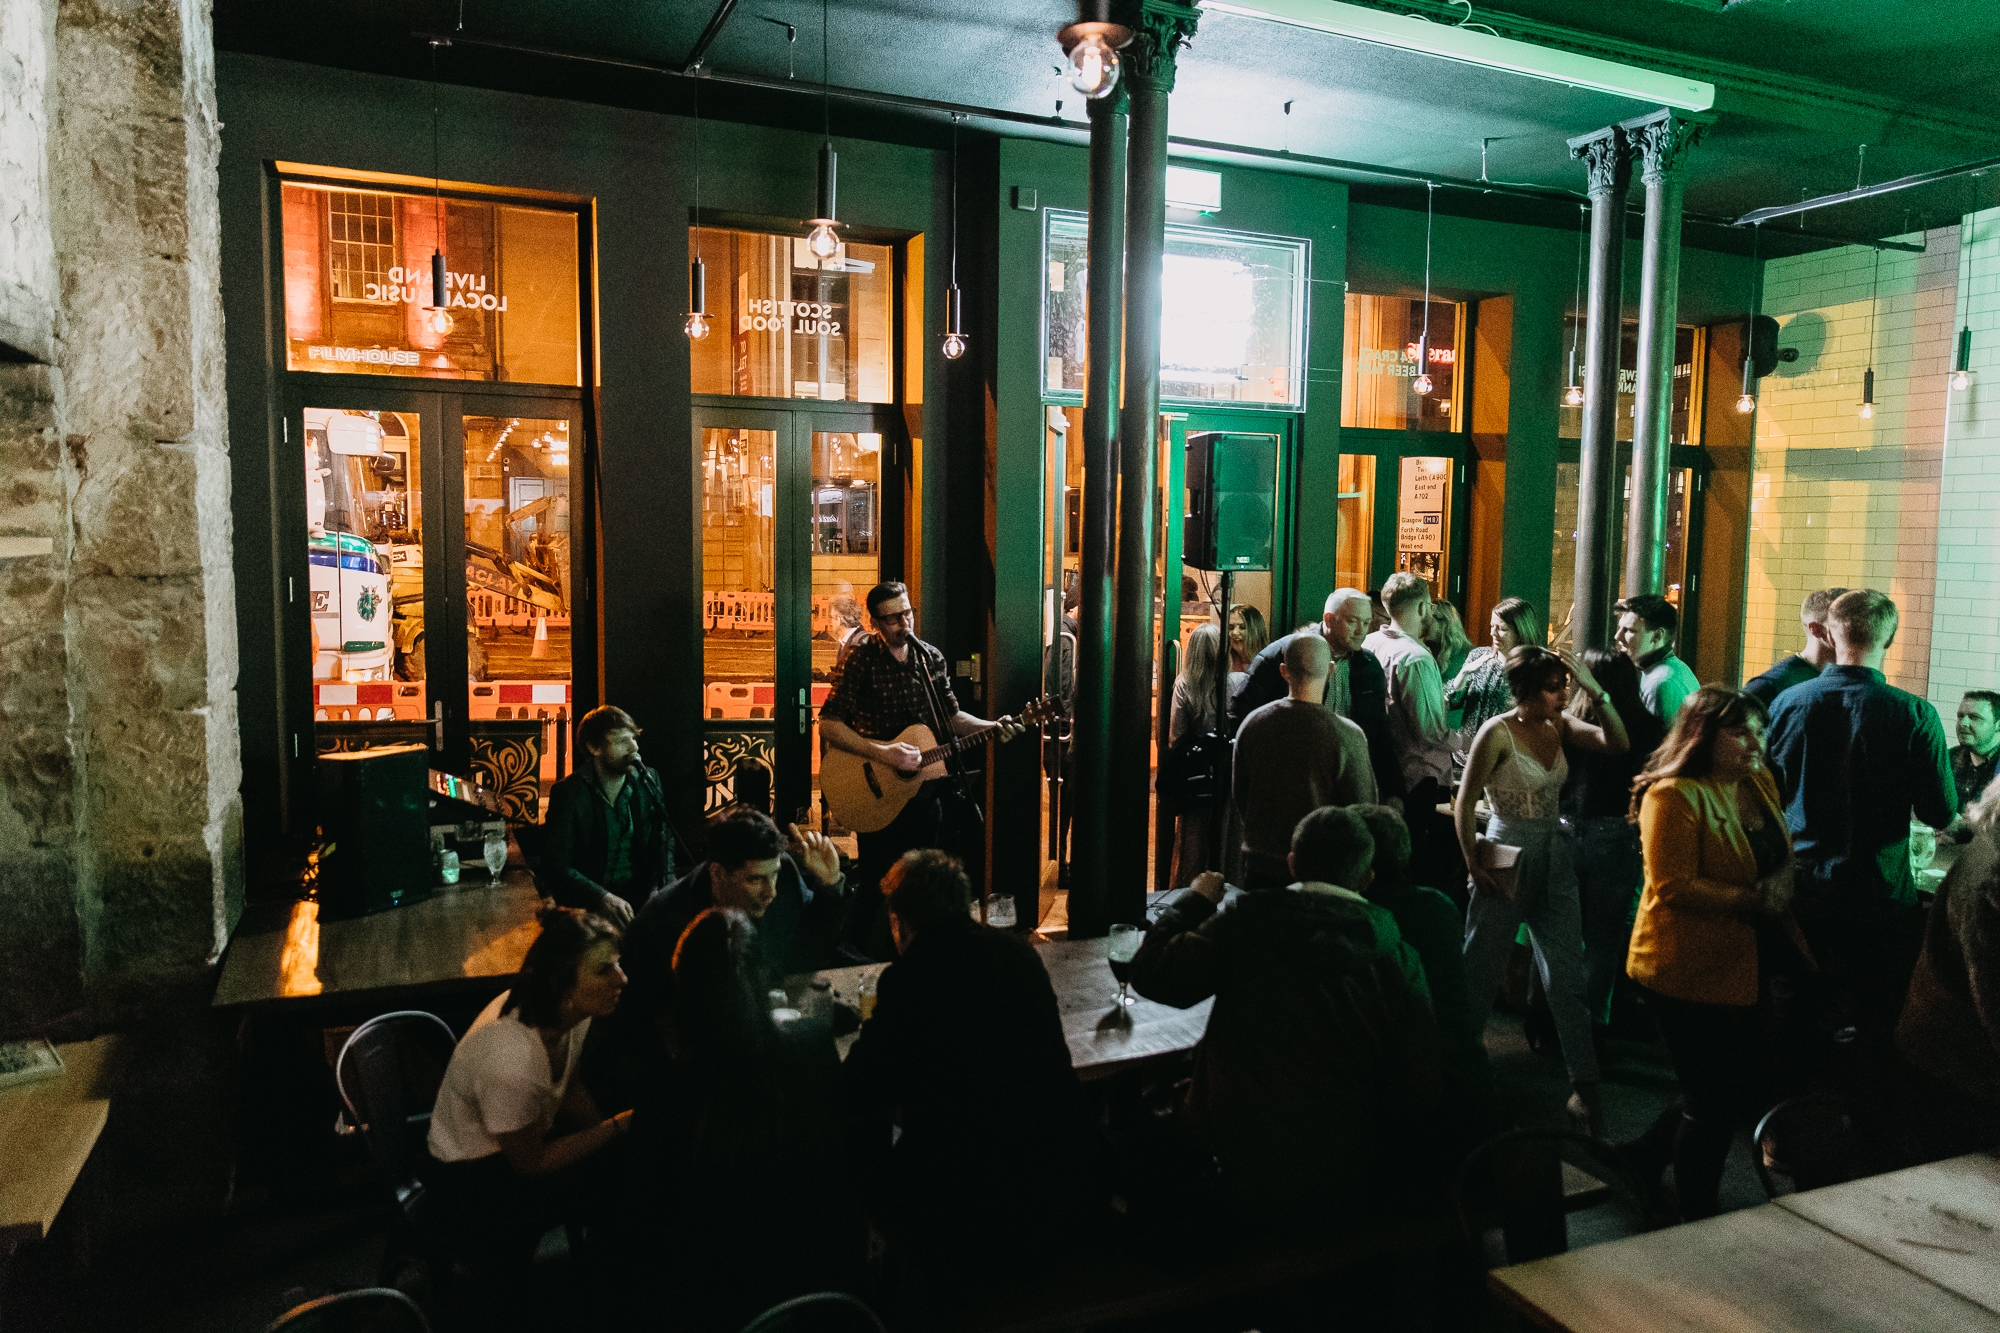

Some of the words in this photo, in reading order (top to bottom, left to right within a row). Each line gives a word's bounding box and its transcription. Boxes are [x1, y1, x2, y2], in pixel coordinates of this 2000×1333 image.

[308, 346, 420, 366] FILMHOUSE
[1401, 517, 1422, 525] Glasgow
[1400, 534, 1417, 542] Bridge
